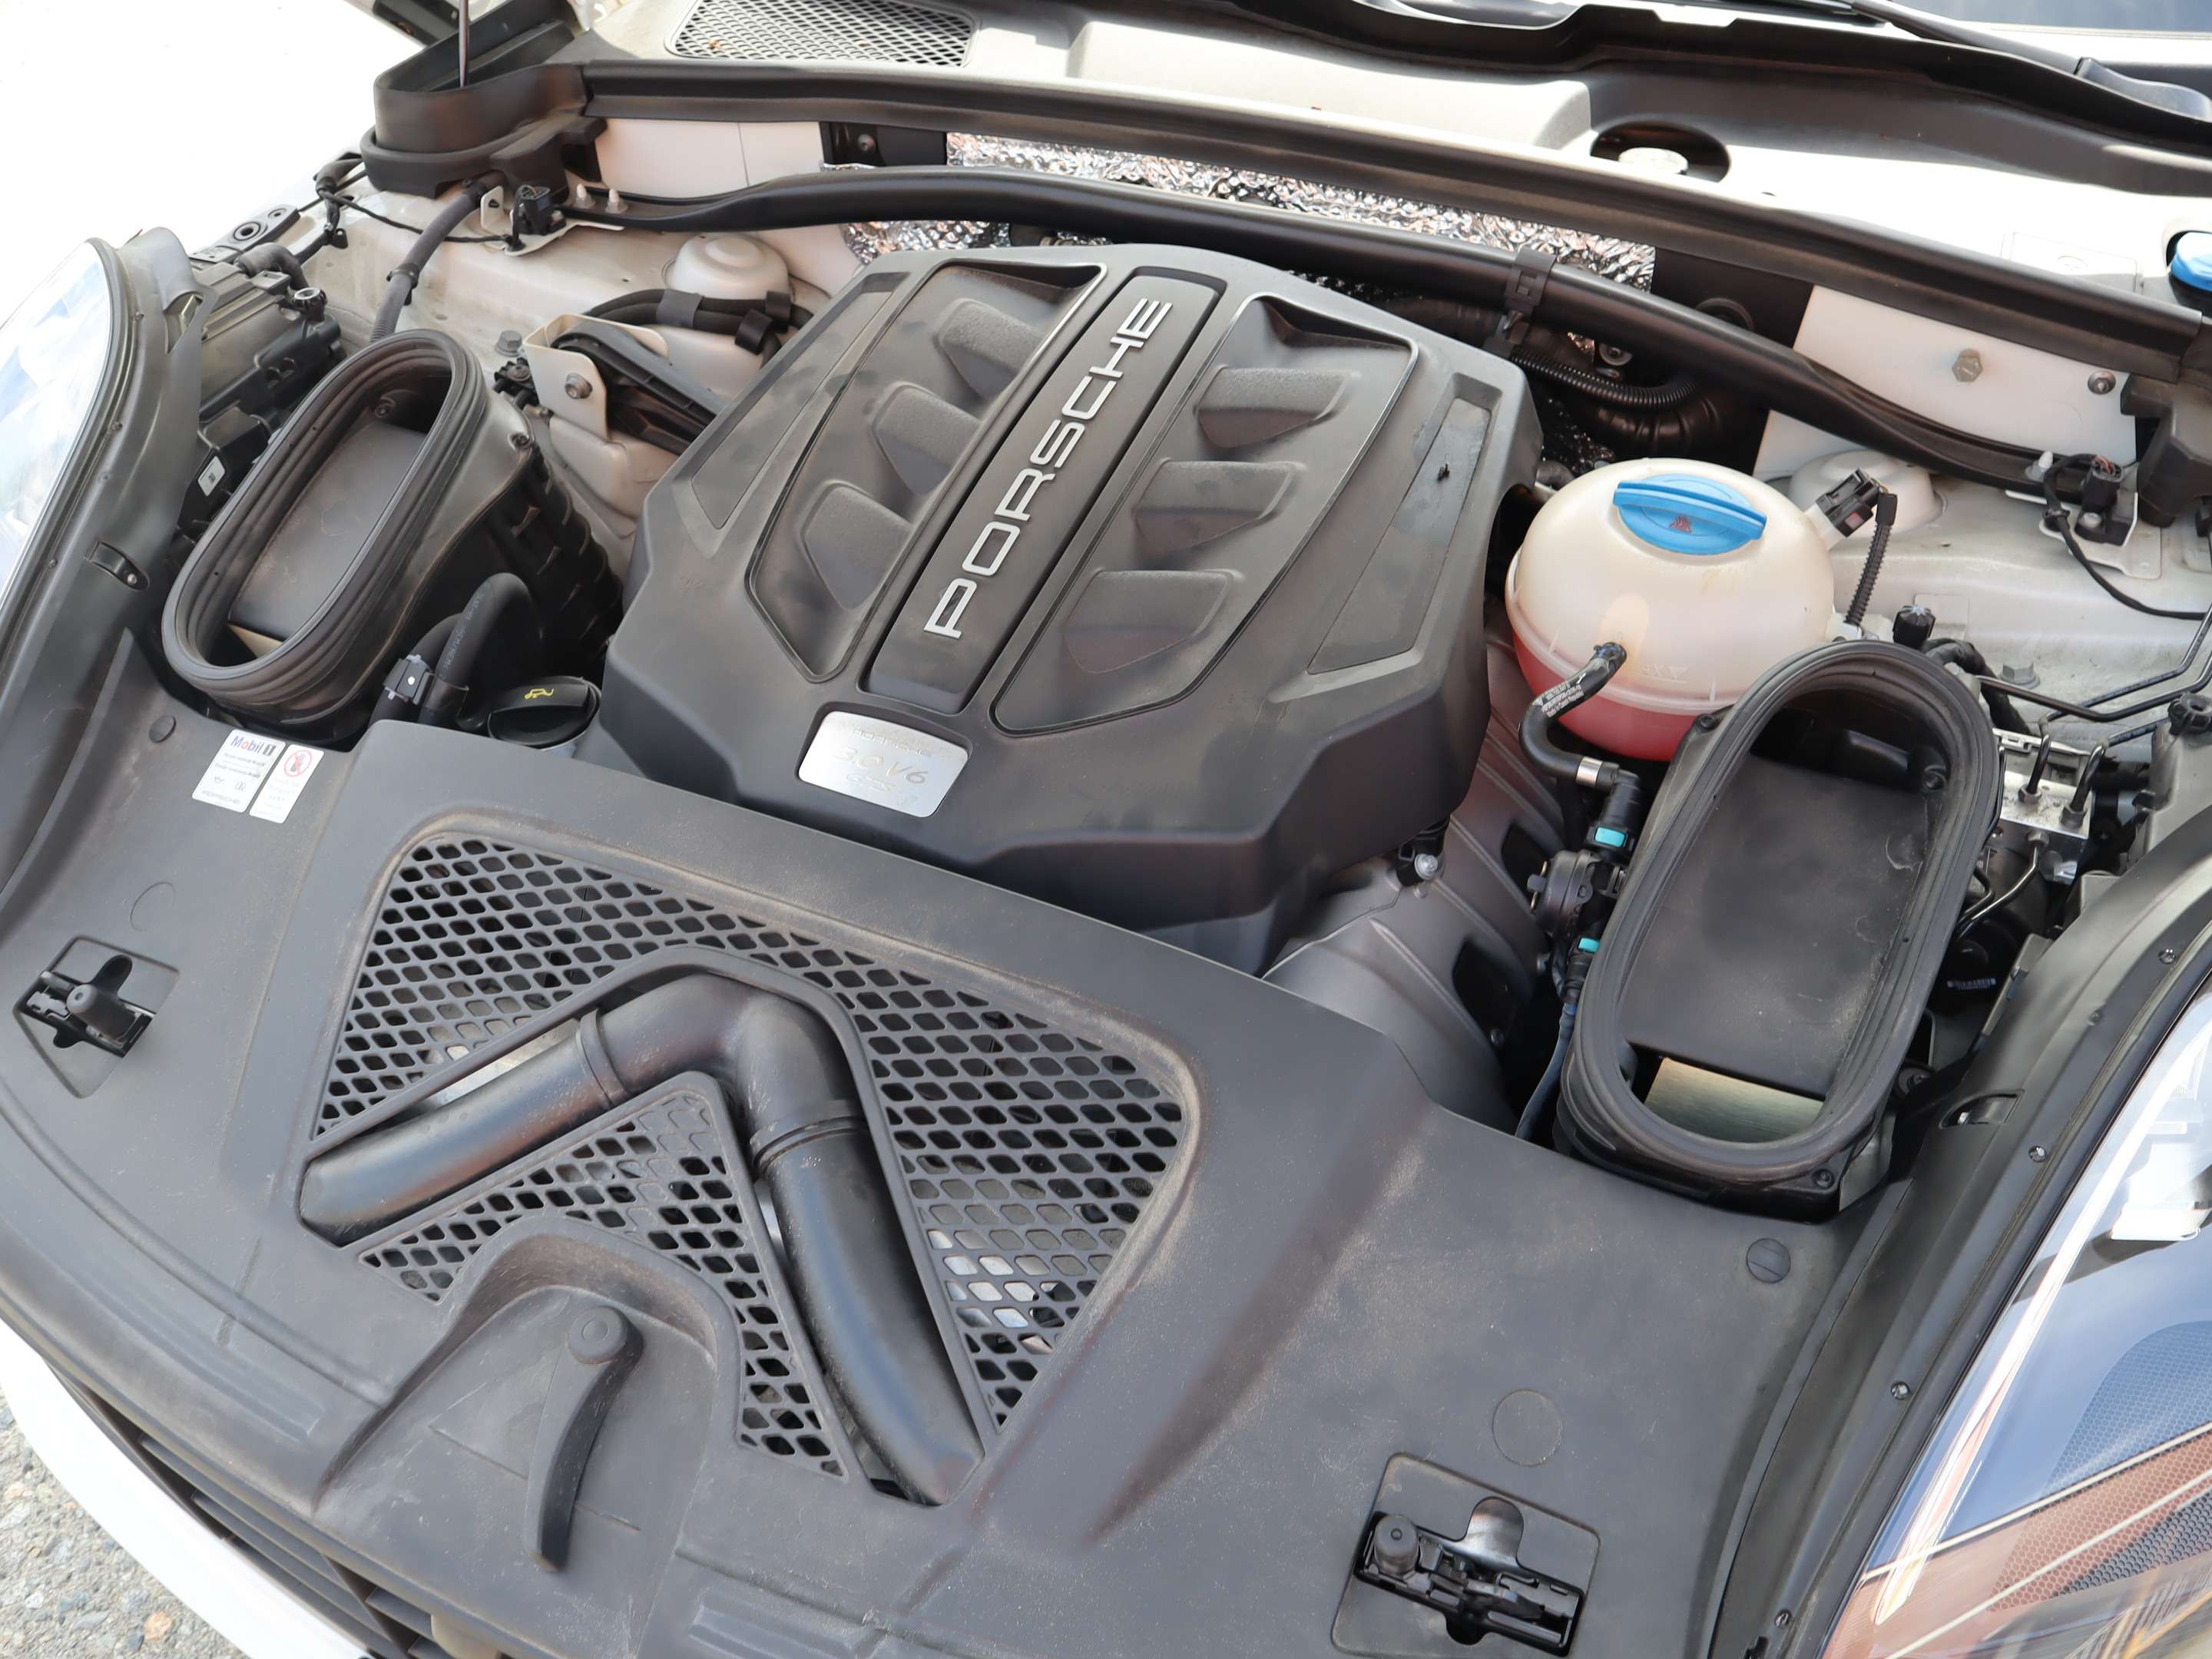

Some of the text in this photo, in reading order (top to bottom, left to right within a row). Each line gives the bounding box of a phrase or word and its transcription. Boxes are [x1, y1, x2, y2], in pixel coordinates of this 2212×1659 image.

[923, 298, 1173, 639] PORSCHE
[231, 735, 265, 753] Mobil
[885, 760, 929, 784] V6
